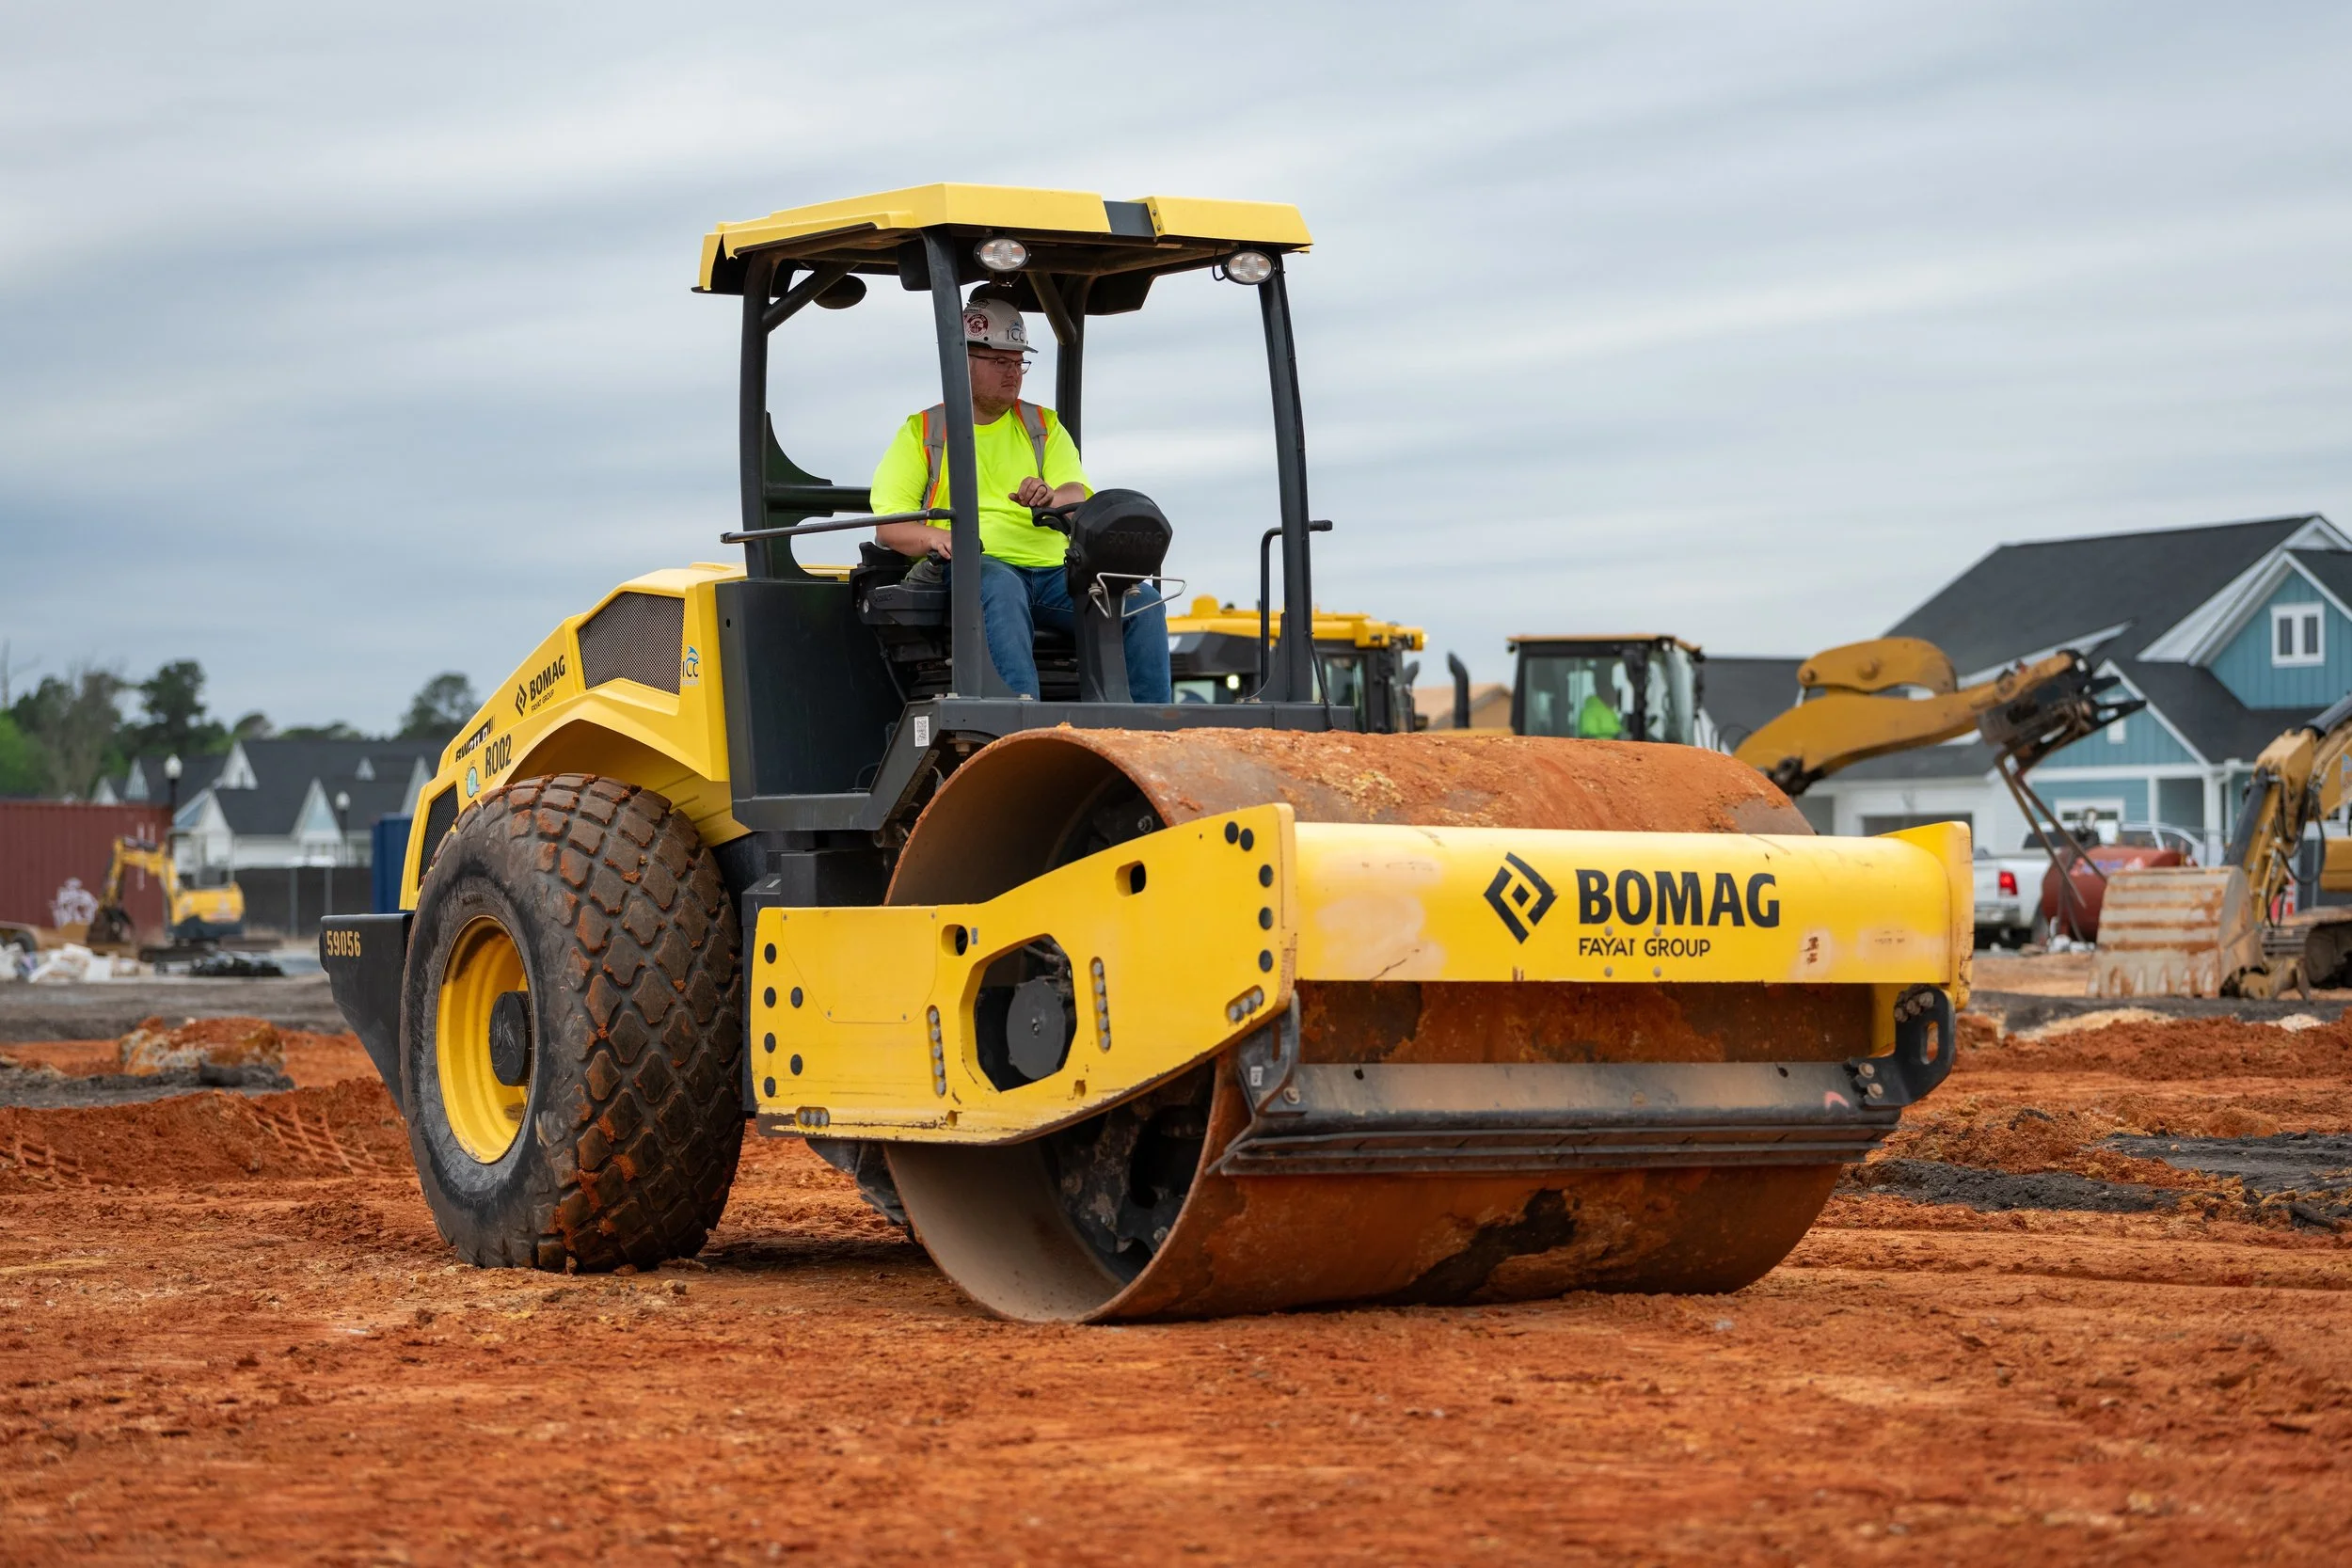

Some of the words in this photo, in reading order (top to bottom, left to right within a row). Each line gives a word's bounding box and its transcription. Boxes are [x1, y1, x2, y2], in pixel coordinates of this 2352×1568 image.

[1007, 329, 1025, 342] ICC
[529, 654, 566, 702] BOMAG
[682, 660, 699, 677] ICC
[1575, 868, 1780, 928] BOMAG
[326, 929, 361, 958] 59056
[1578, 937, 1636, 957] FAYAT
[1644, 938, 1711, 958] GROUP
